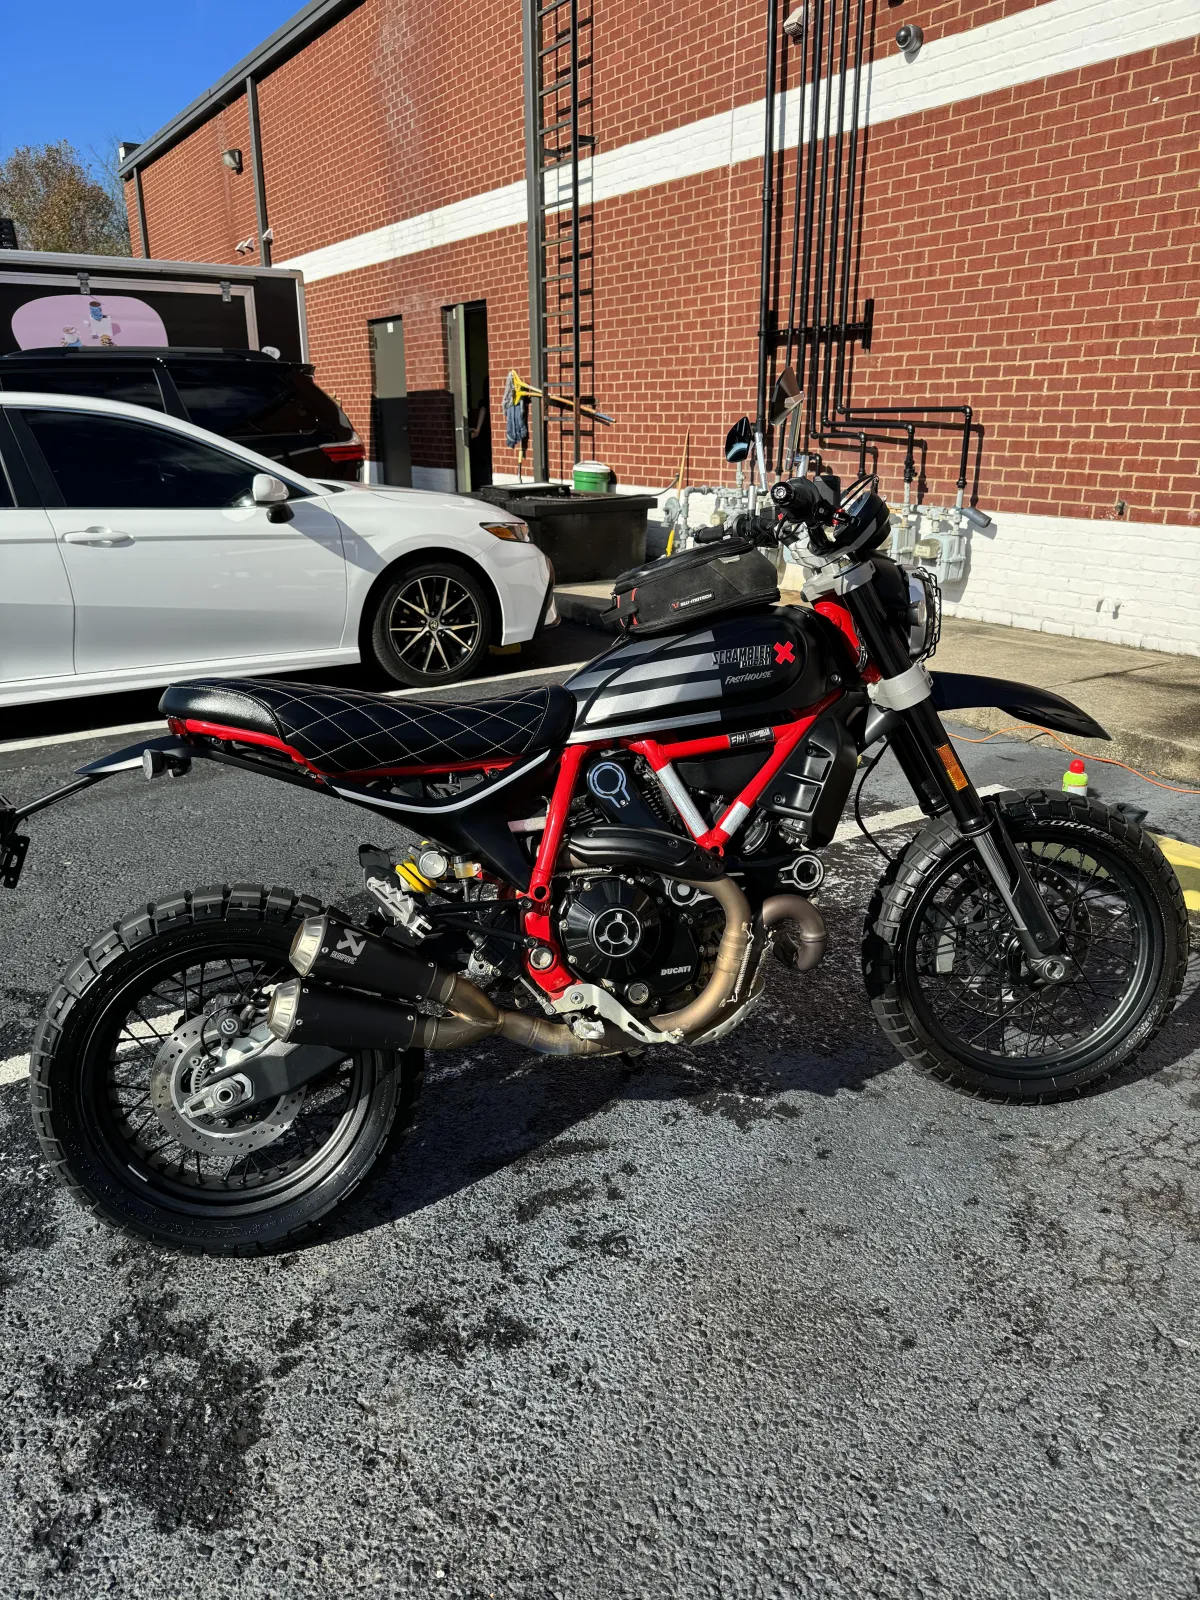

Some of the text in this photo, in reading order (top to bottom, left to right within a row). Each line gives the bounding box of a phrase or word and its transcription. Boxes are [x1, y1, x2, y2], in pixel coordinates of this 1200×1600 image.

[712, 644, 772, 666] SCRAMBLER
[740, 657, 772, 669] DUCATI
[724, 670, 774, 684] FASTHOUSE
[661, 965, 691, 976] DUCATI
